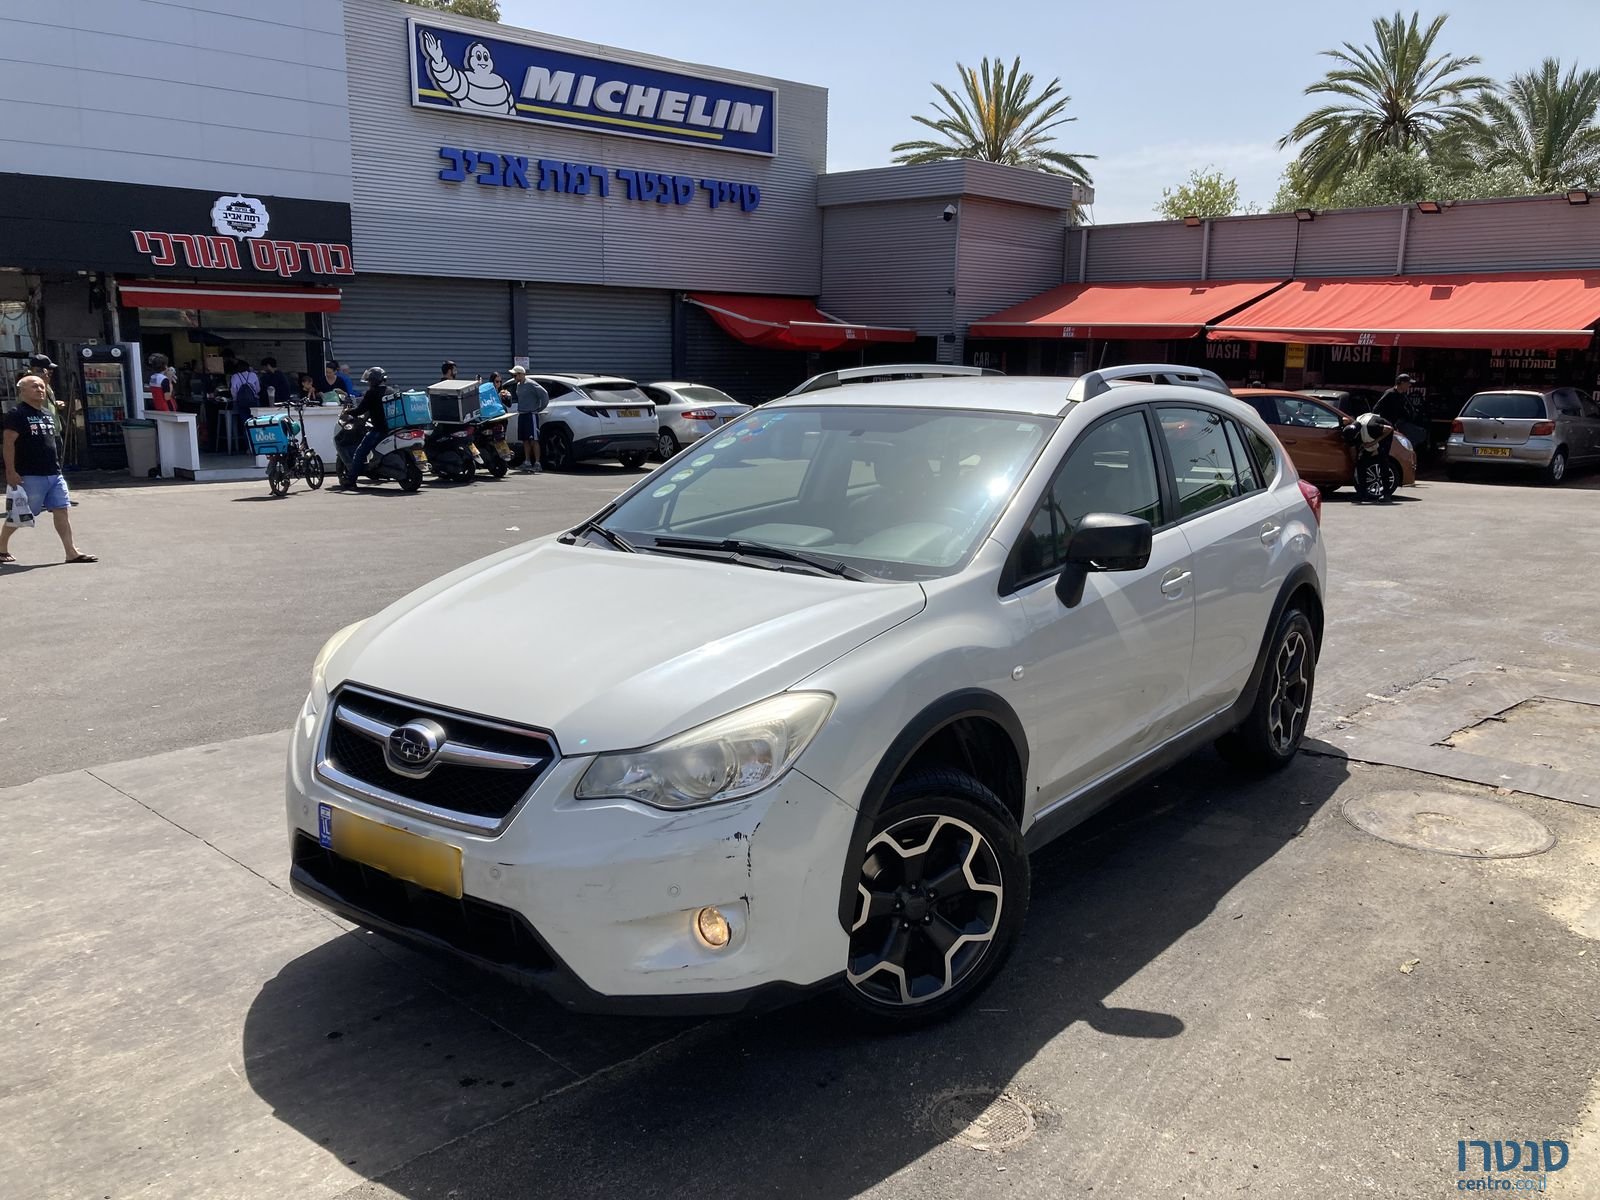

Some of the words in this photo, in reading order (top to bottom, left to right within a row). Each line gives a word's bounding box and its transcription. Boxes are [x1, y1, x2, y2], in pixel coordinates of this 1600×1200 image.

[520, 66, 764, 134] MICHELIN
[438, 146, 531, 189] אביב
[537, 158, 610, 197] רמת
[616, 168, 695, 205] סנטר
[700, 178, 761, 212] טייר
[222, 212, 242, 220] אביב
[243, 214, 260, 222] רמת
[130, 230, 242, 270] תורכי
[247, 238, 355, 277] בורקס
[973, 352, 990, 367] CAR
[1206, 343, 1240, 359] WASH
[1331, 346, 1371, 362] WASH
[255, 429, 276, 442] Wolt
